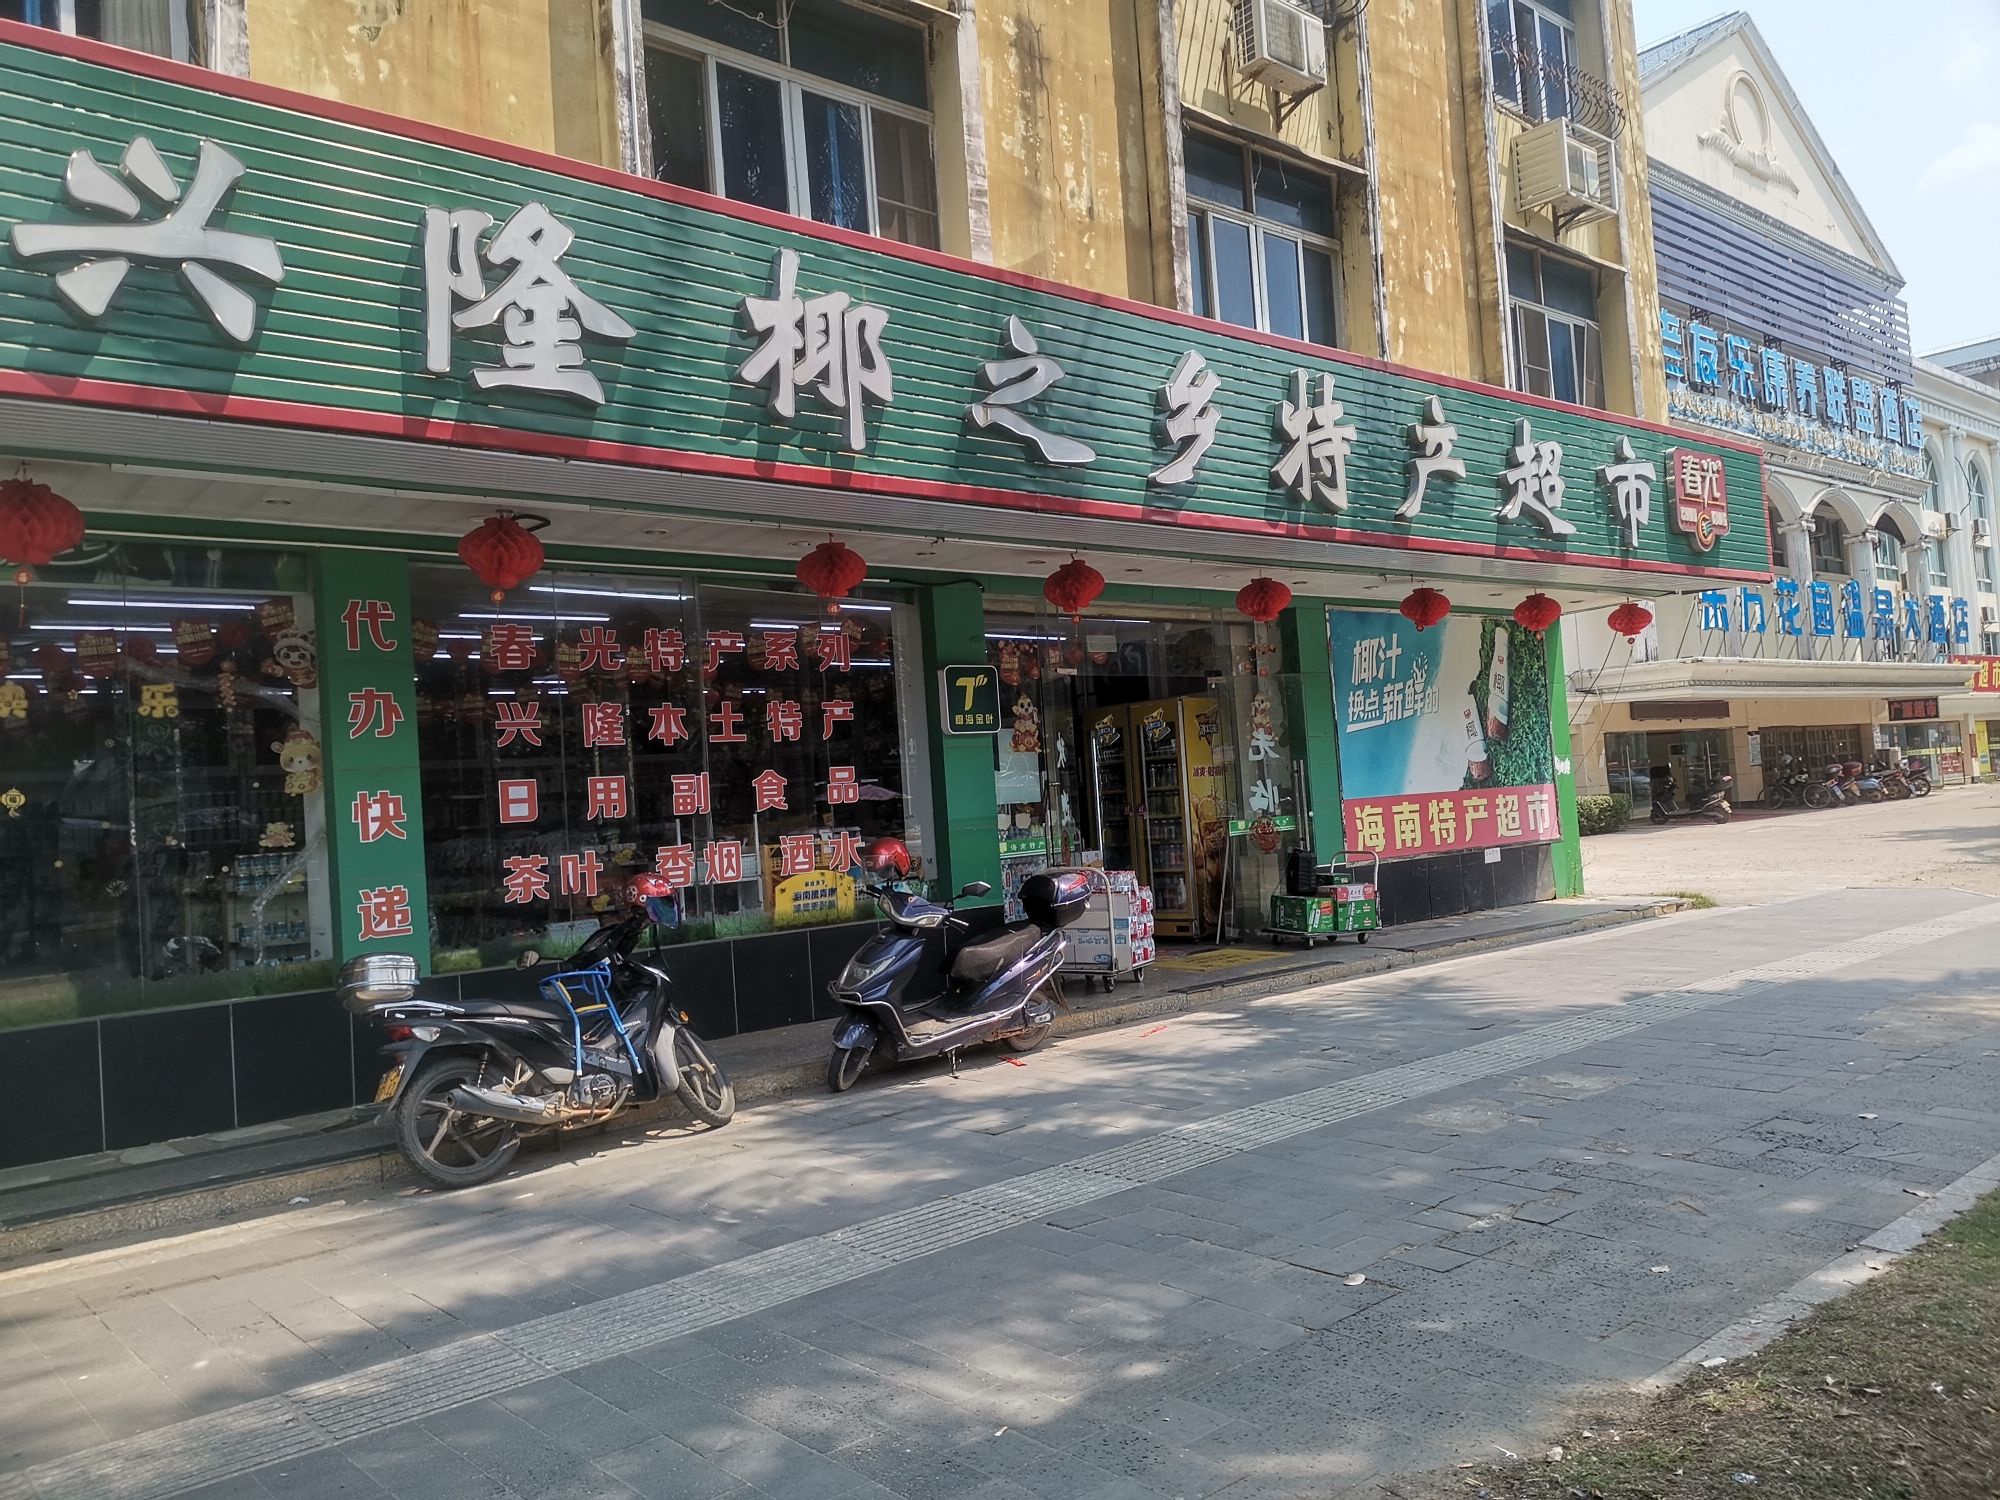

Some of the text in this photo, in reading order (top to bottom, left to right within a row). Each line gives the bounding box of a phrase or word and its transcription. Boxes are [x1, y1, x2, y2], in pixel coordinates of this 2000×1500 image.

[10, 135, 1657, 548] 兴隆椰之乡特产超市
[1681, 455, 1721, 508] 春光
[490, 623, 852, 672] 春光特产系列
[1351, 633, 1403, 686] 椰汁
[495, 699, 854, 748] 兴隆本土特产
[1348, 679, 1440, 723] 换点新鲜的
[341, 600, 412, 941] 代办快递
[498, 766, 860, 823] 日用副食品
[1355, 791, 1552, 853] 海南特产超市
[503, 831, 863, 903] 茶叶 香烟 酒水
